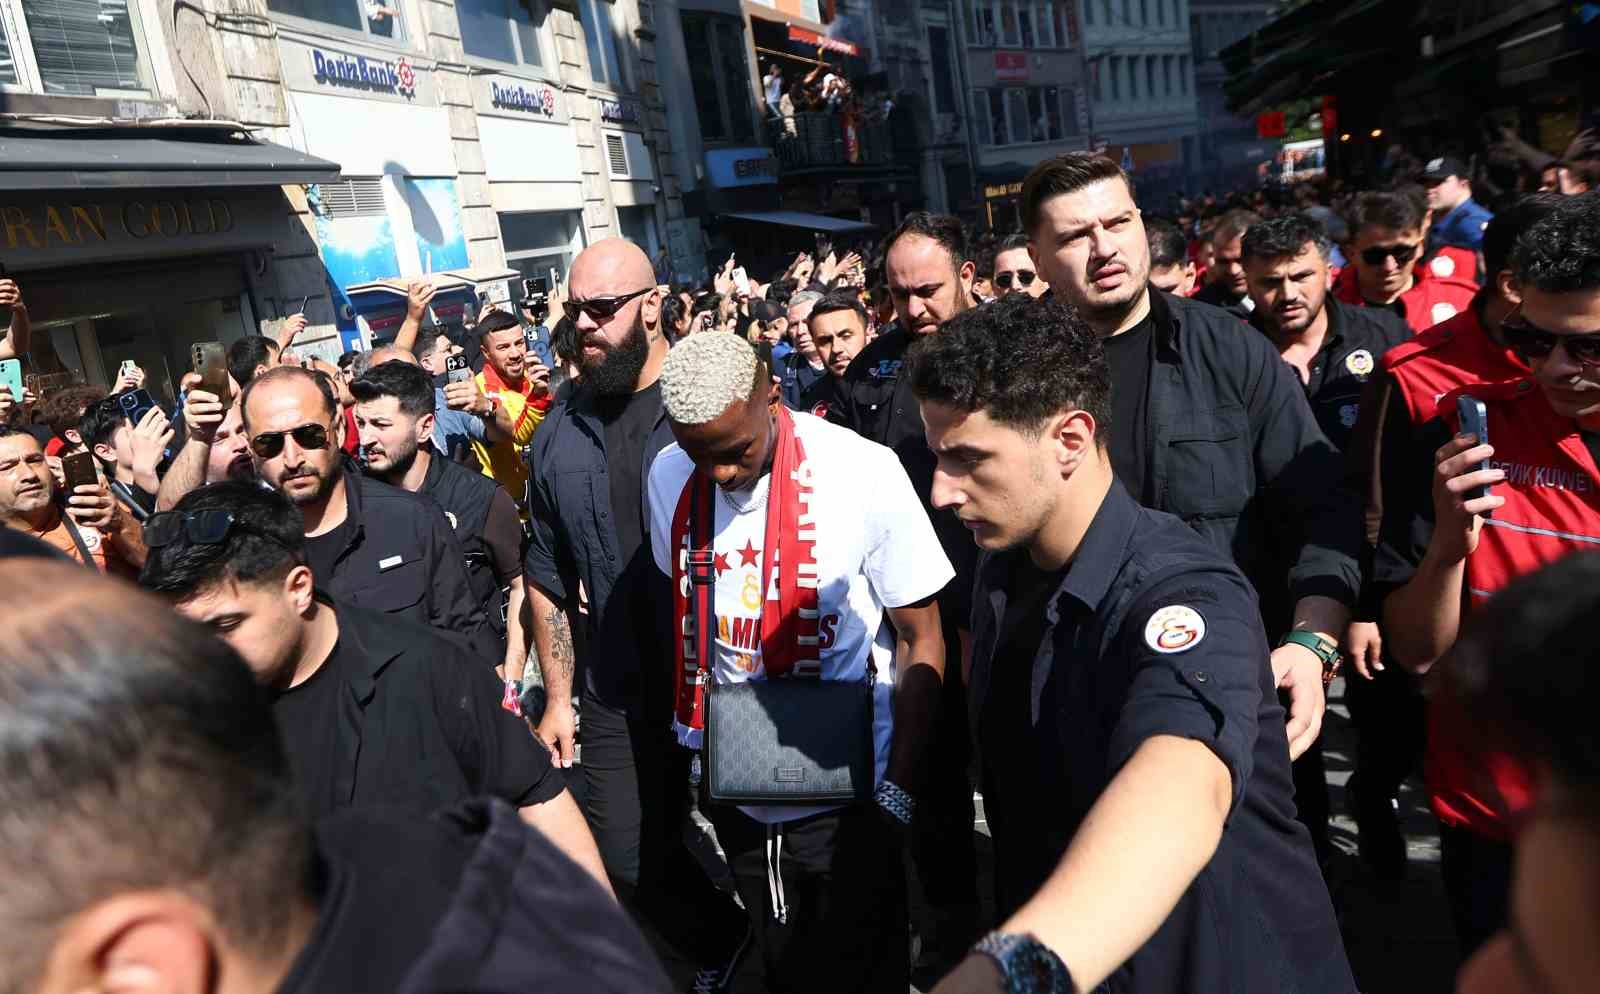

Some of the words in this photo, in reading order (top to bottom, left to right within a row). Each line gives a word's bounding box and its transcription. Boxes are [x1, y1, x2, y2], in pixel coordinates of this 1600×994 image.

[312, 50, 399, 90] DenizBank
[490, 81, 545, 112] DenizBank
[121, 199, 234, 239] GOLD
